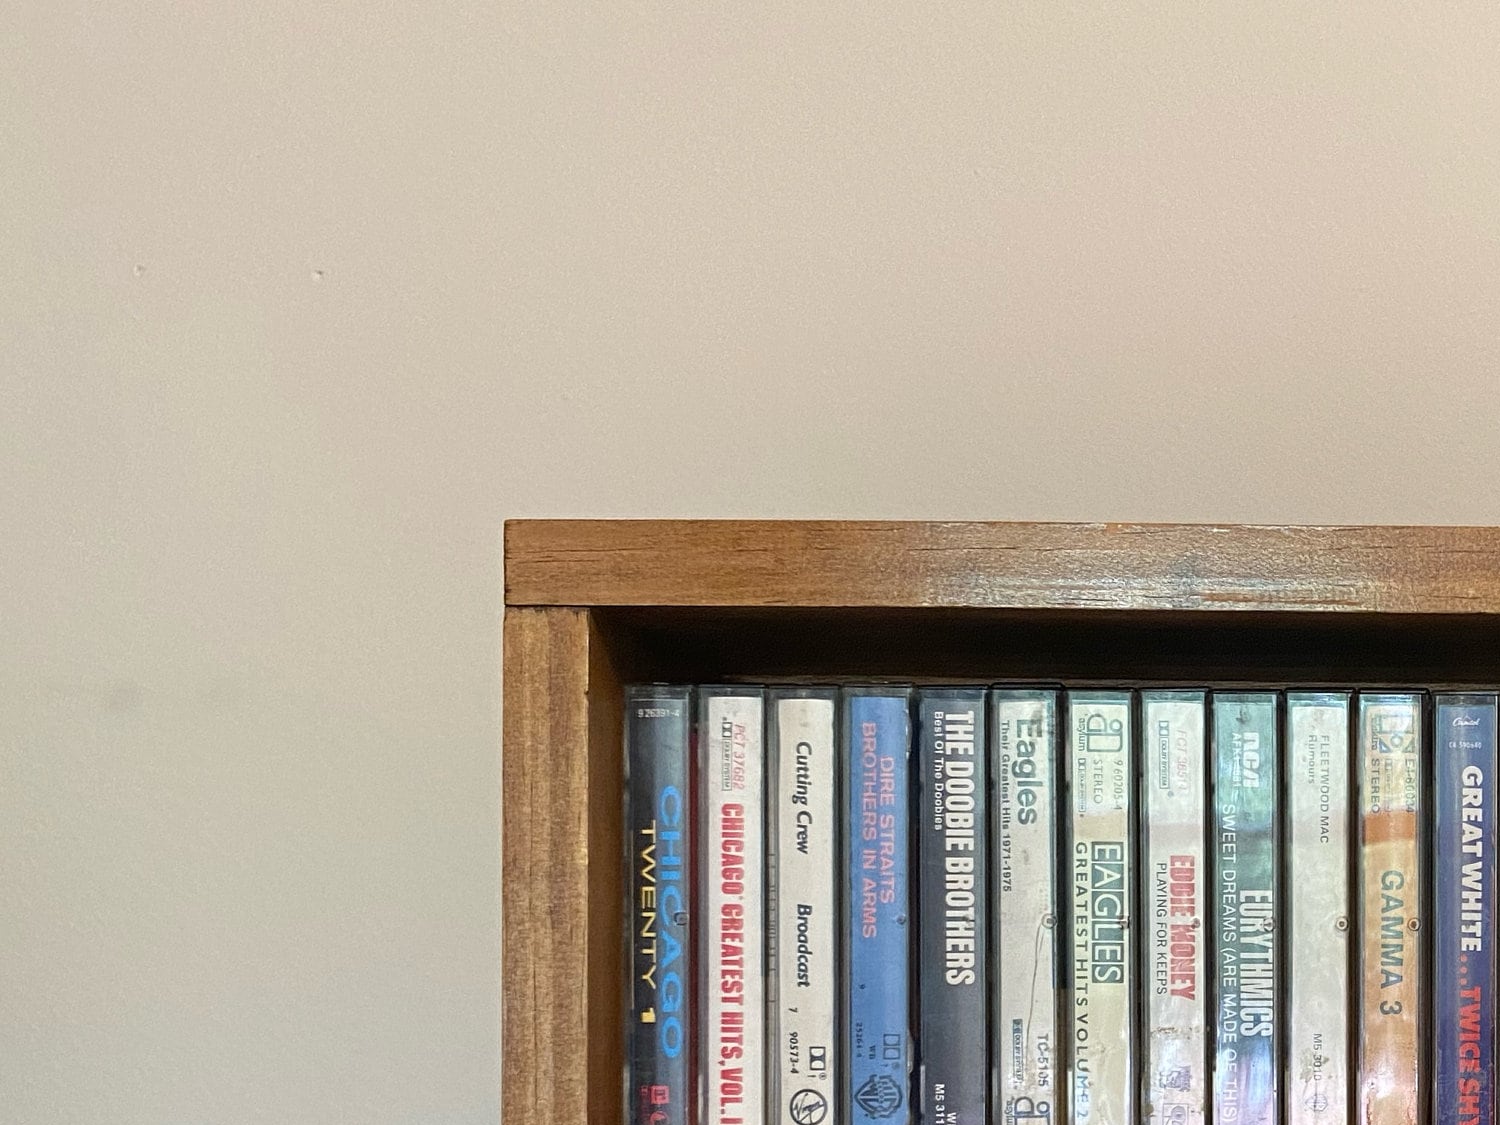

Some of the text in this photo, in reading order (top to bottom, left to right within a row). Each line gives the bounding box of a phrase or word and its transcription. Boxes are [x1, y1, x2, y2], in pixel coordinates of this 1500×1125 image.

[793, 742, 811, 854] Cutting Crew
[934, 711, 943, 830] Best Of The Doobies
[1001, 720, 1011, 892] Their Greatest Hits 1971-1975
[1013, 719, 1042, 825] Eagles
[1306, 735, 1317, 784] Rumours
[1320, 735, 1330, 843] FLEETWOOD MAC
[879, 757, 894, 903] DIRE STRAITS
[946, 711, 975, 985] THE DOOBIE BROTHERS
[659, 785, 683, 1059] CHICAGO
[797, 904, 812, 987] Broadcast
[1092, 843, 1123, 983] EAGLES
[1155, 862, 1167, 995] PLAYING FOR KEEPS
[1169, 855, 1195, 1000] EDDIE MONEY
[1240, 890, 1272, 1037] EURYTHMICS
[1380, 870, 1404, 1015] GAMMA 3
[935, 1084, 944, 1101] M5
